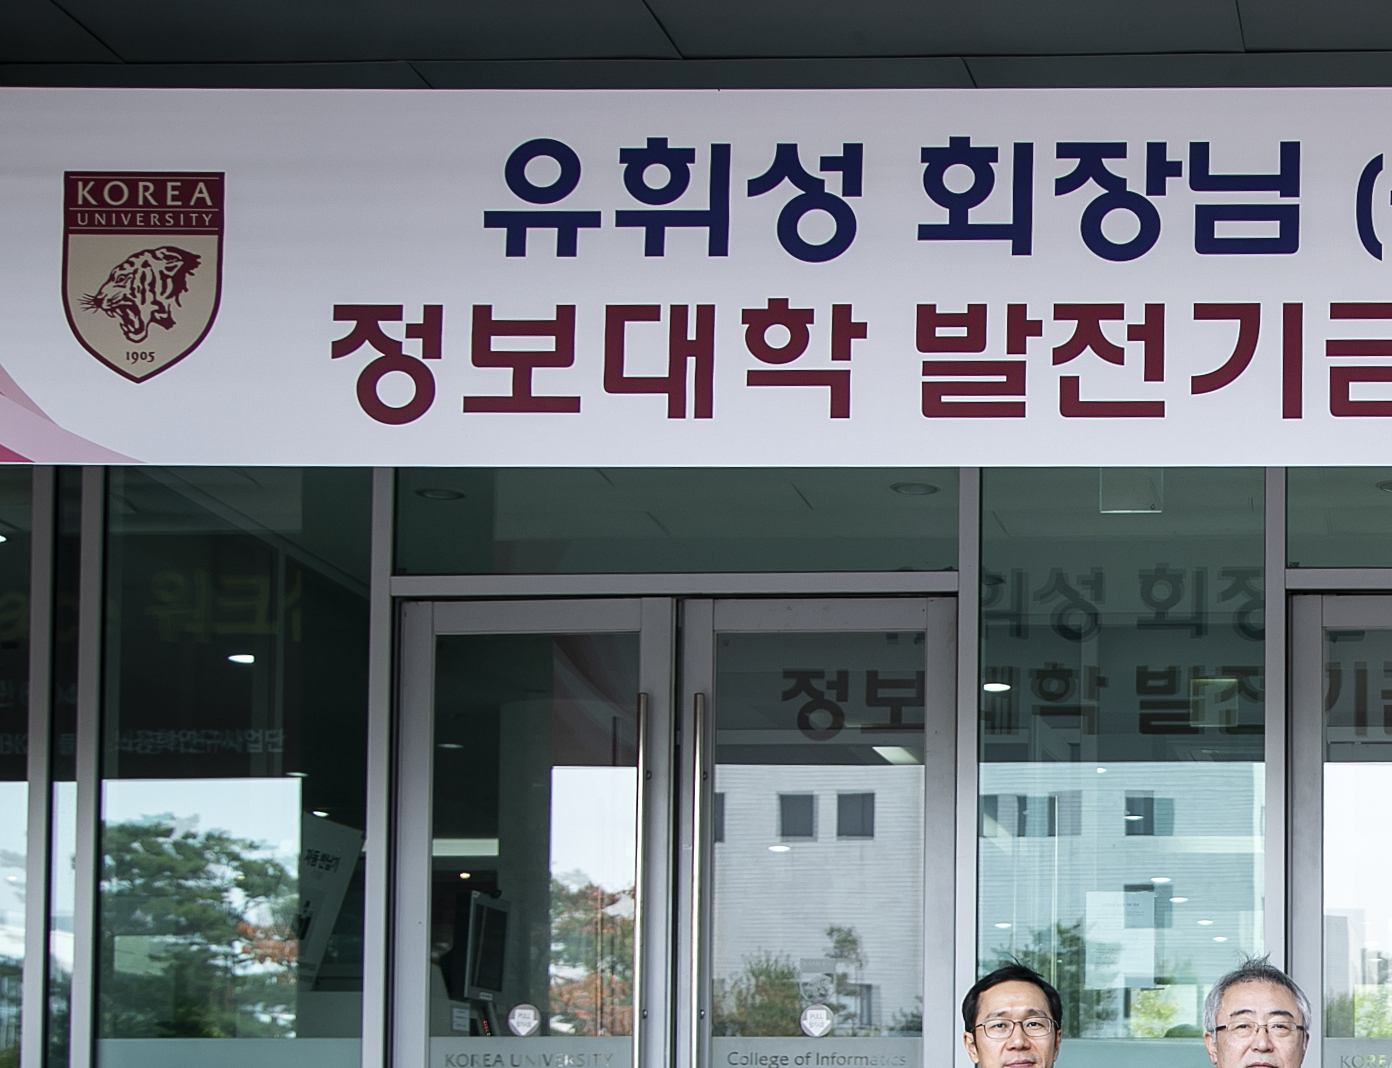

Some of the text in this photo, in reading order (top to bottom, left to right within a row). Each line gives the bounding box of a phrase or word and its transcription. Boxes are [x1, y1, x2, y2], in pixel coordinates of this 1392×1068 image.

[78, 181, 213, 206] KOREA
[484, 137, 863, 262] 유휘성
[918, 136, 1300, 262] 회장님
[77, 213, 213, 227] UNIVERSITY
[125, 351, 156, 366] 1905
[332, 298, 867, 425] 정보대학
[445, 1053, 613, 1068] KOREA UNIVERSITY
[794, 1050, 812, 1066] of
[815, 1051, 907, 1067] Informatics
